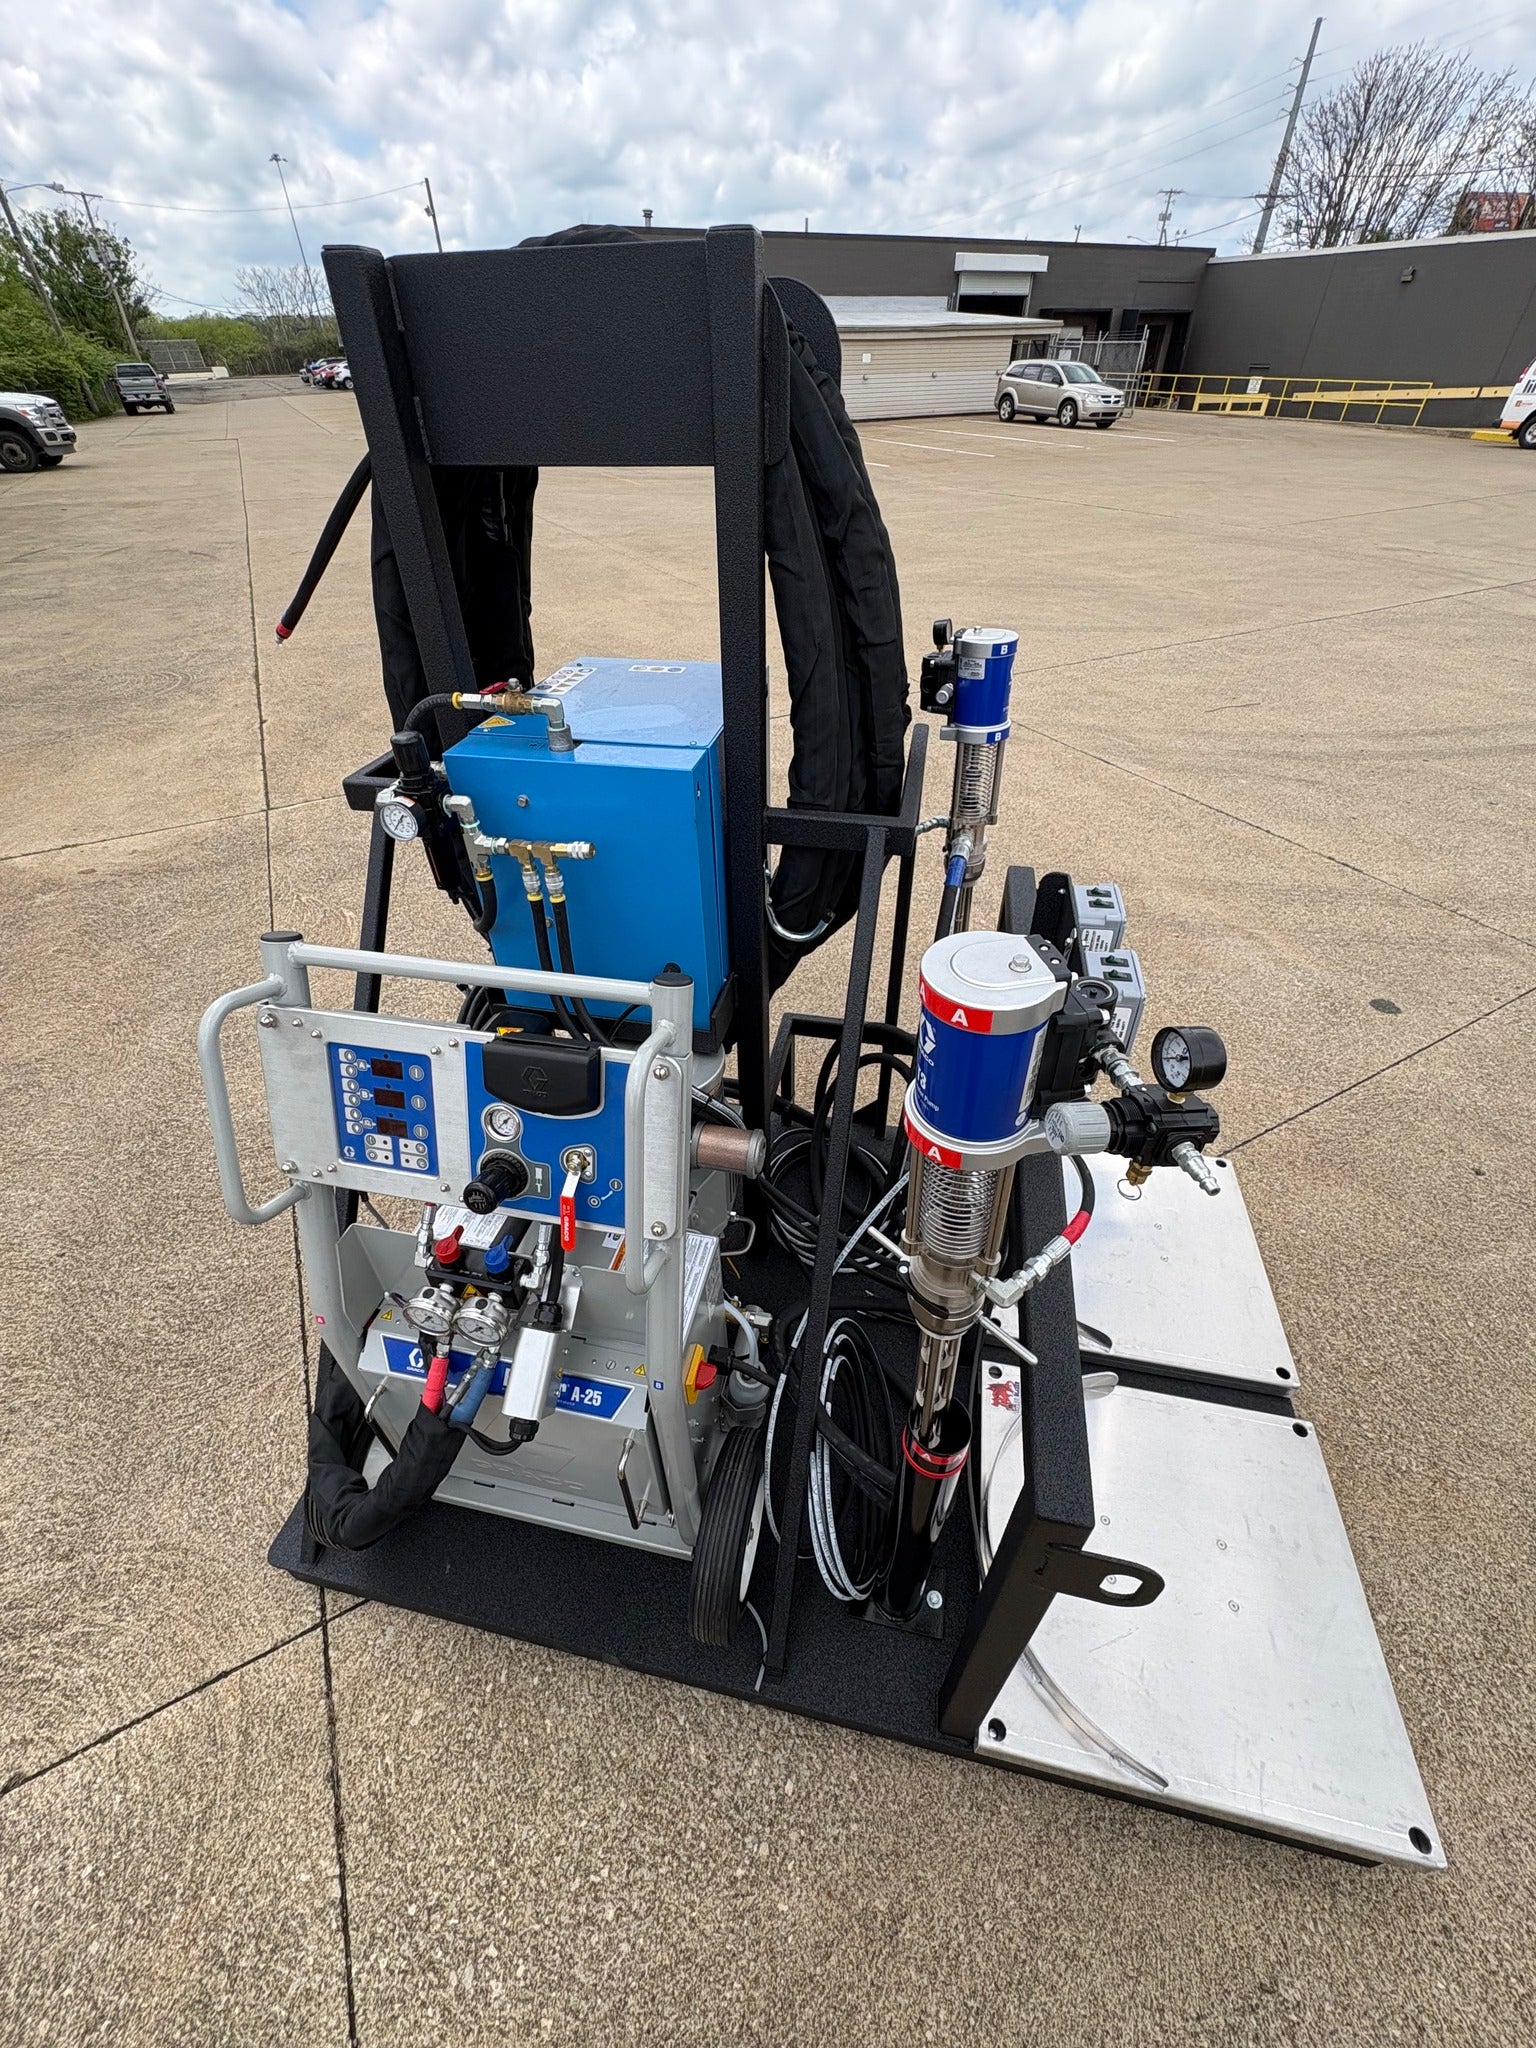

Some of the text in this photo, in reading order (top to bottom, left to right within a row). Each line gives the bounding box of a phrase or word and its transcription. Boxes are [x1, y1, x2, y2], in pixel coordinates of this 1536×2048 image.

[1000, 645, 1008, 655] B
[994, 732, 1002, 741] B
[951, 1008, 969, 1027] A
[927, 1146, 943, 1162] A
[571, 1386, 603, 1407] A-25
[920, 1452, 933, 1463] A
